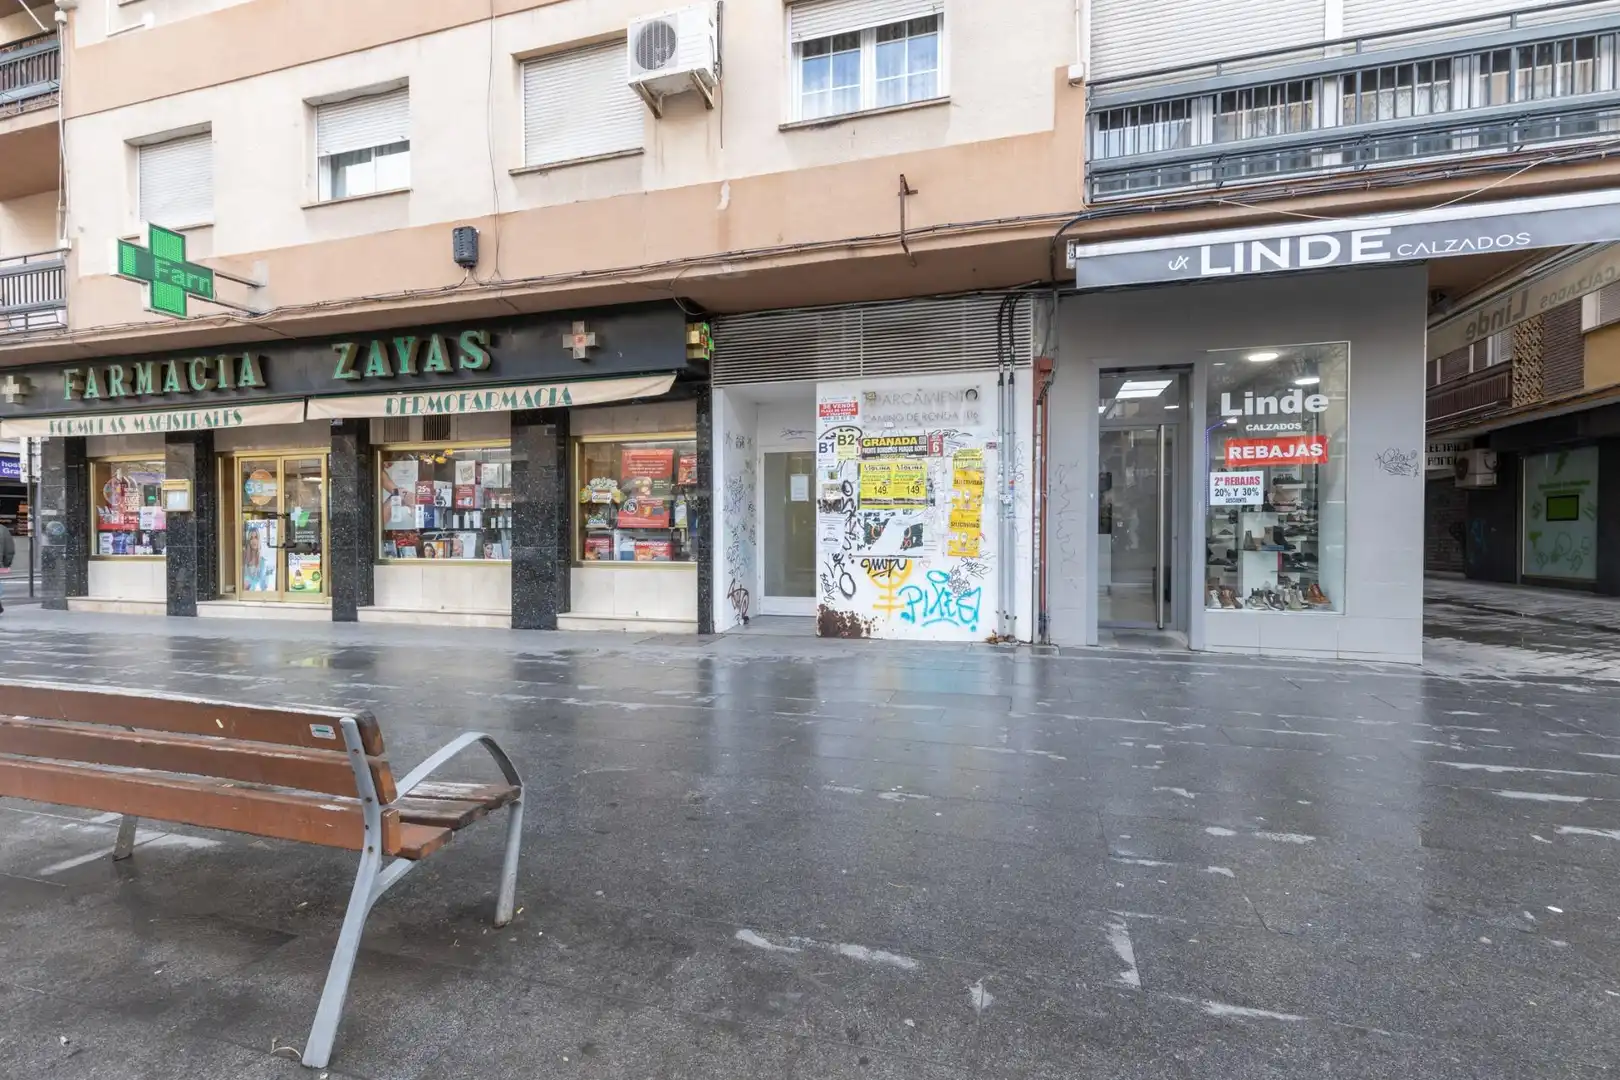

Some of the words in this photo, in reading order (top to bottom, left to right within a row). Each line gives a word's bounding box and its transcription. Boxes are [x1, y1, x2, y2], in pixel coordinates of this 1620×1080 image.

[1200, 227, 1392, 275] LINDE
[1397, 232, 1532, 257] CALZADOS
[63, 351, 267, 402] FARMACIA
[331, 328, 491, 381] ZAYAS
[385, 385, 573, 416] DERMOFARMACIA
[1220, 388, 1329, 417] Linde
[133, 408, 243, 433] MAGISTRALES
[921, 411, 959, 422] RONDA
[1245, 422, 1302, 432] CALZADOS
[837, 434, 856, 446] B2
[862, 436, 918, 447] GRANADA
[818, 442, 835, 454] B1
[932, 441, 939, 453] 6
[1228, 443, 1324, 460] REBAJAS
[1224, 475, 1261, 486] REBAJAS
[1214, 488, 1232, 497] 20%
[1232, 488, 1239, 497] Y
[1242, 487, 1260, 496] 30%
